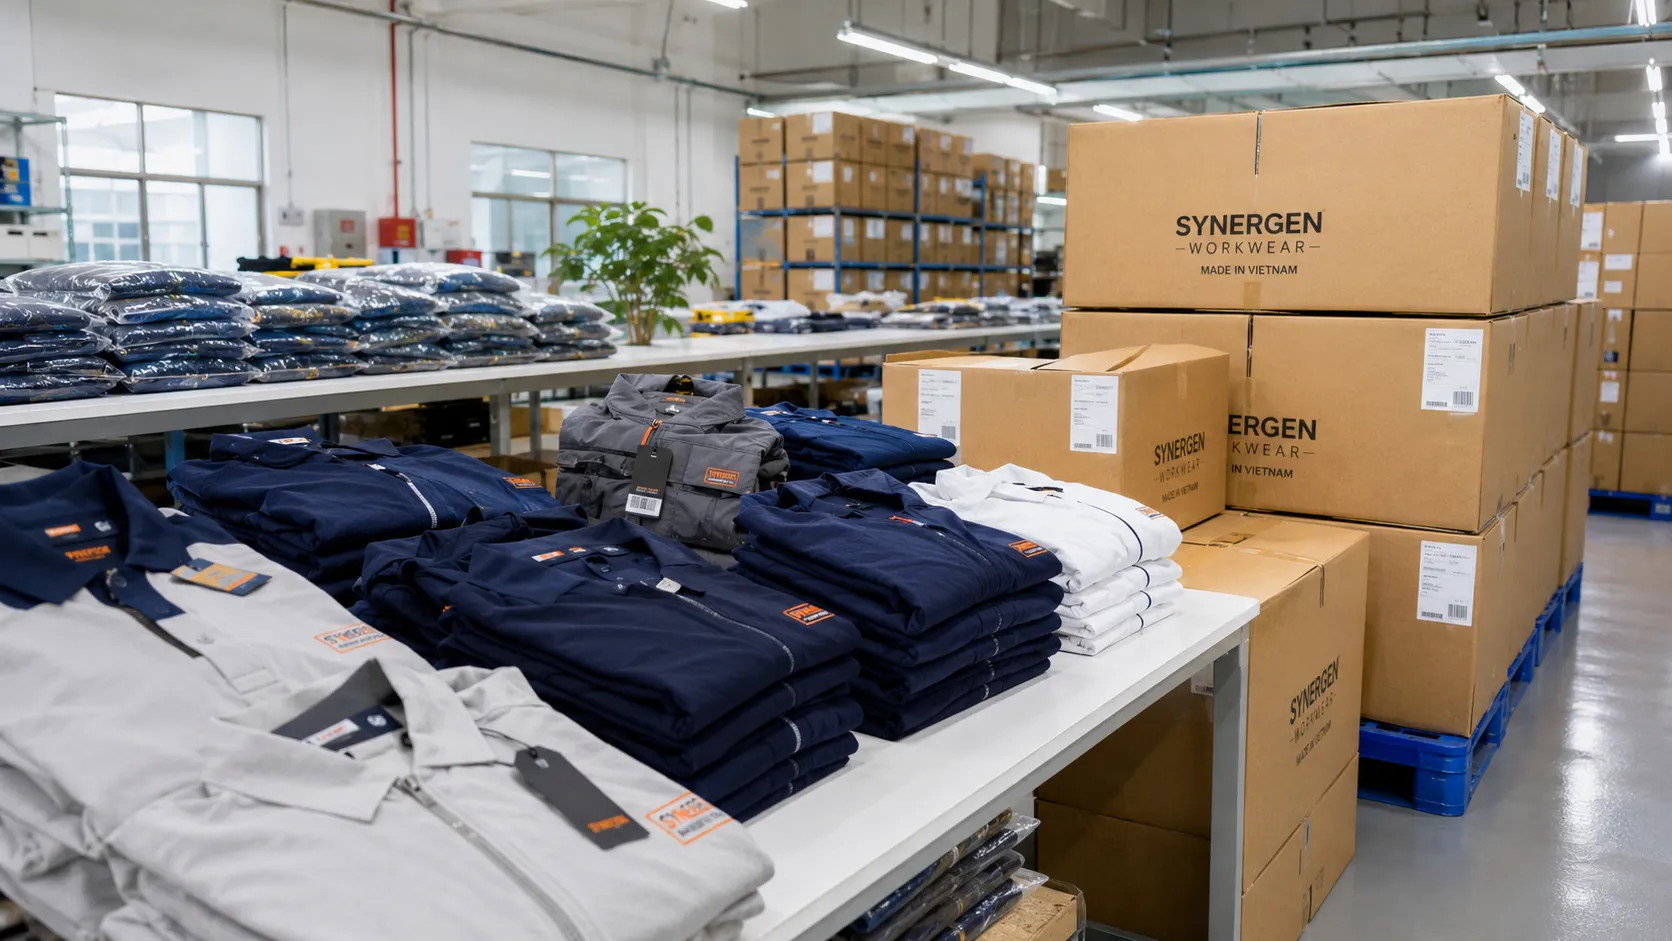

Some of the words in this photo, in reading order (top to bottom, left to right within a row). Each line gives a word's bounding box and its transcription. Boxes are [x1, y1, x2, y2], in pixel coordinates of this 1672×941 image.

[1175, 211, 1323, 237] SYNERGEN
[1189, 240, 1305, 255] WORKWEAR
[1201, 265, 1231, 275] MADE
[1234, 265, 1246, 275] IN
[1248, 265, 1298, 275] VIETNAM
[1228, 414, 1317, 441] ERGEN
[1154, 431, 1206, 466] SYNERGEN
[1232, 441, 1299, 459] KWEAR
[1231, 464, 1242, 474] IN
[1245, 465, 1293, 479] VIETNAM
[1289, 654, 1340, 725] SYNERGEN
